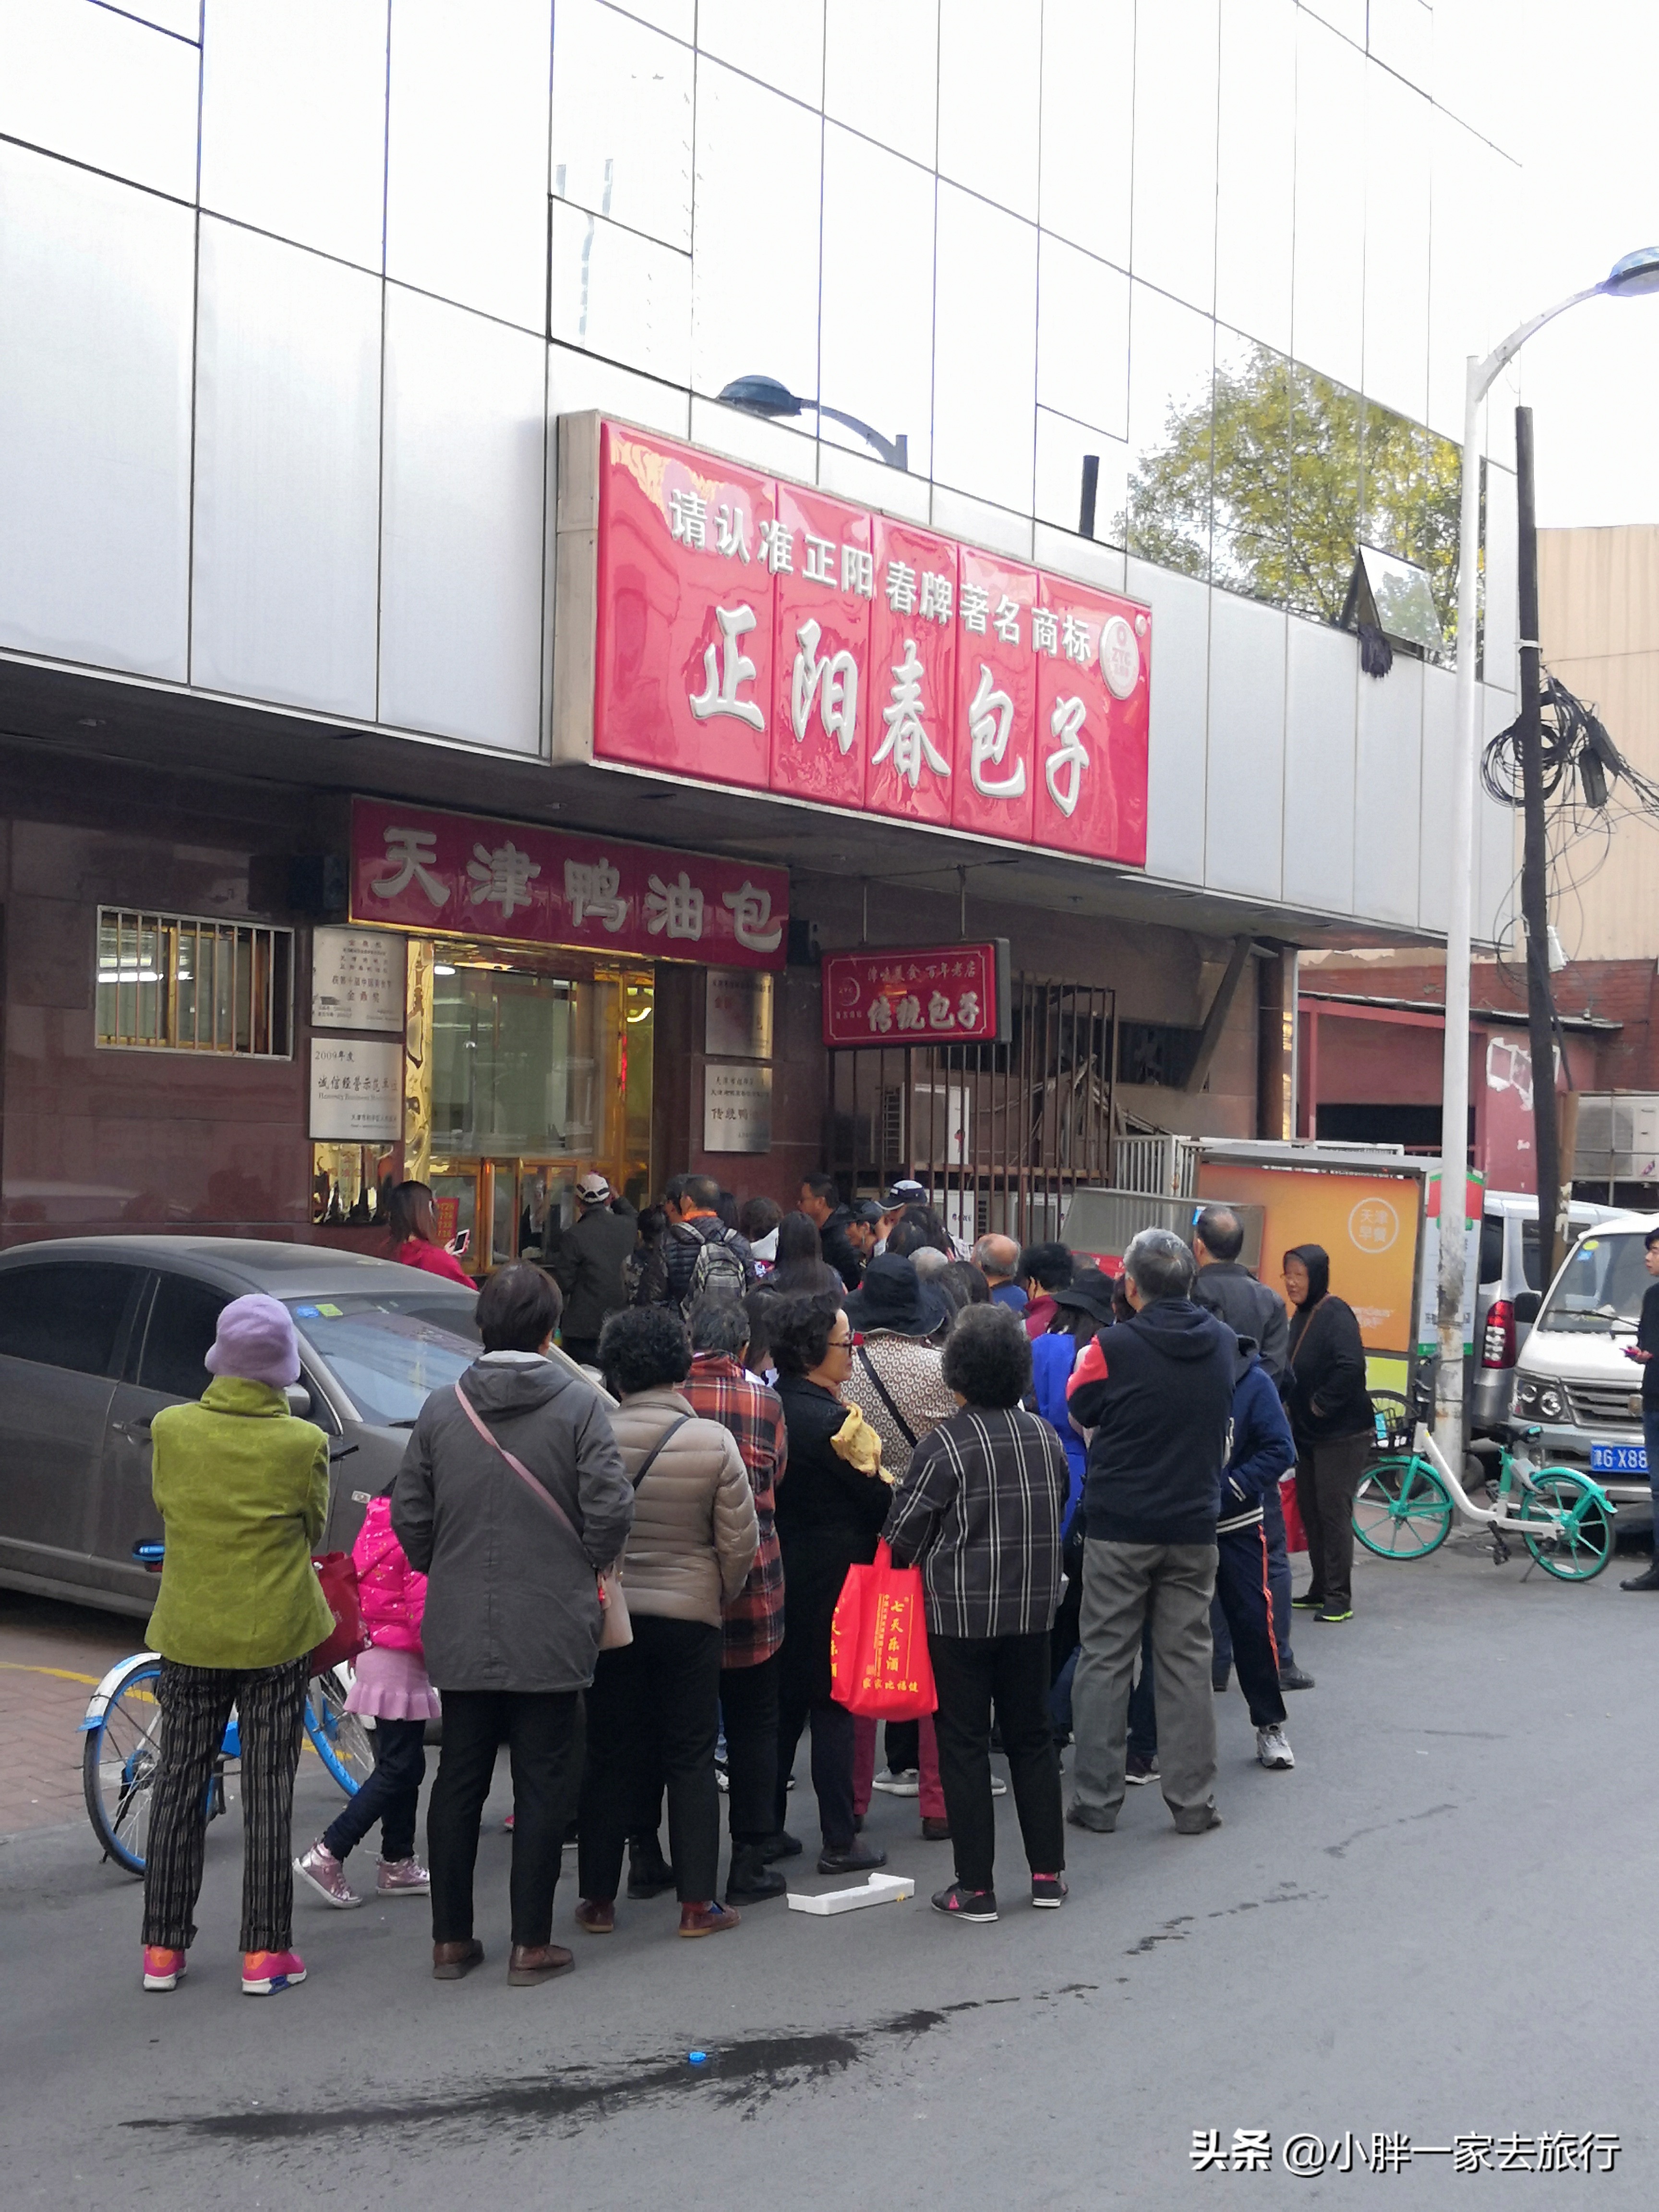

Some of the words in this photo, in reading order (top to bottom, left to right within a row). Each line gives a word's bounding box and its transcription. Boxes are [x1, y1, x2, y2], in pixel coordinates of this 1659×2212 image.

[669, 489, 1092, 663] 请认准正阳春牌著名商标
[689, 604, 1090, 817] 正阳春包子
[371, 827, 782, 952] 天津鸭油包
[867, 990, 980, 1033] 传统包子
[1360, 1209, 1389, 1225] 天津
